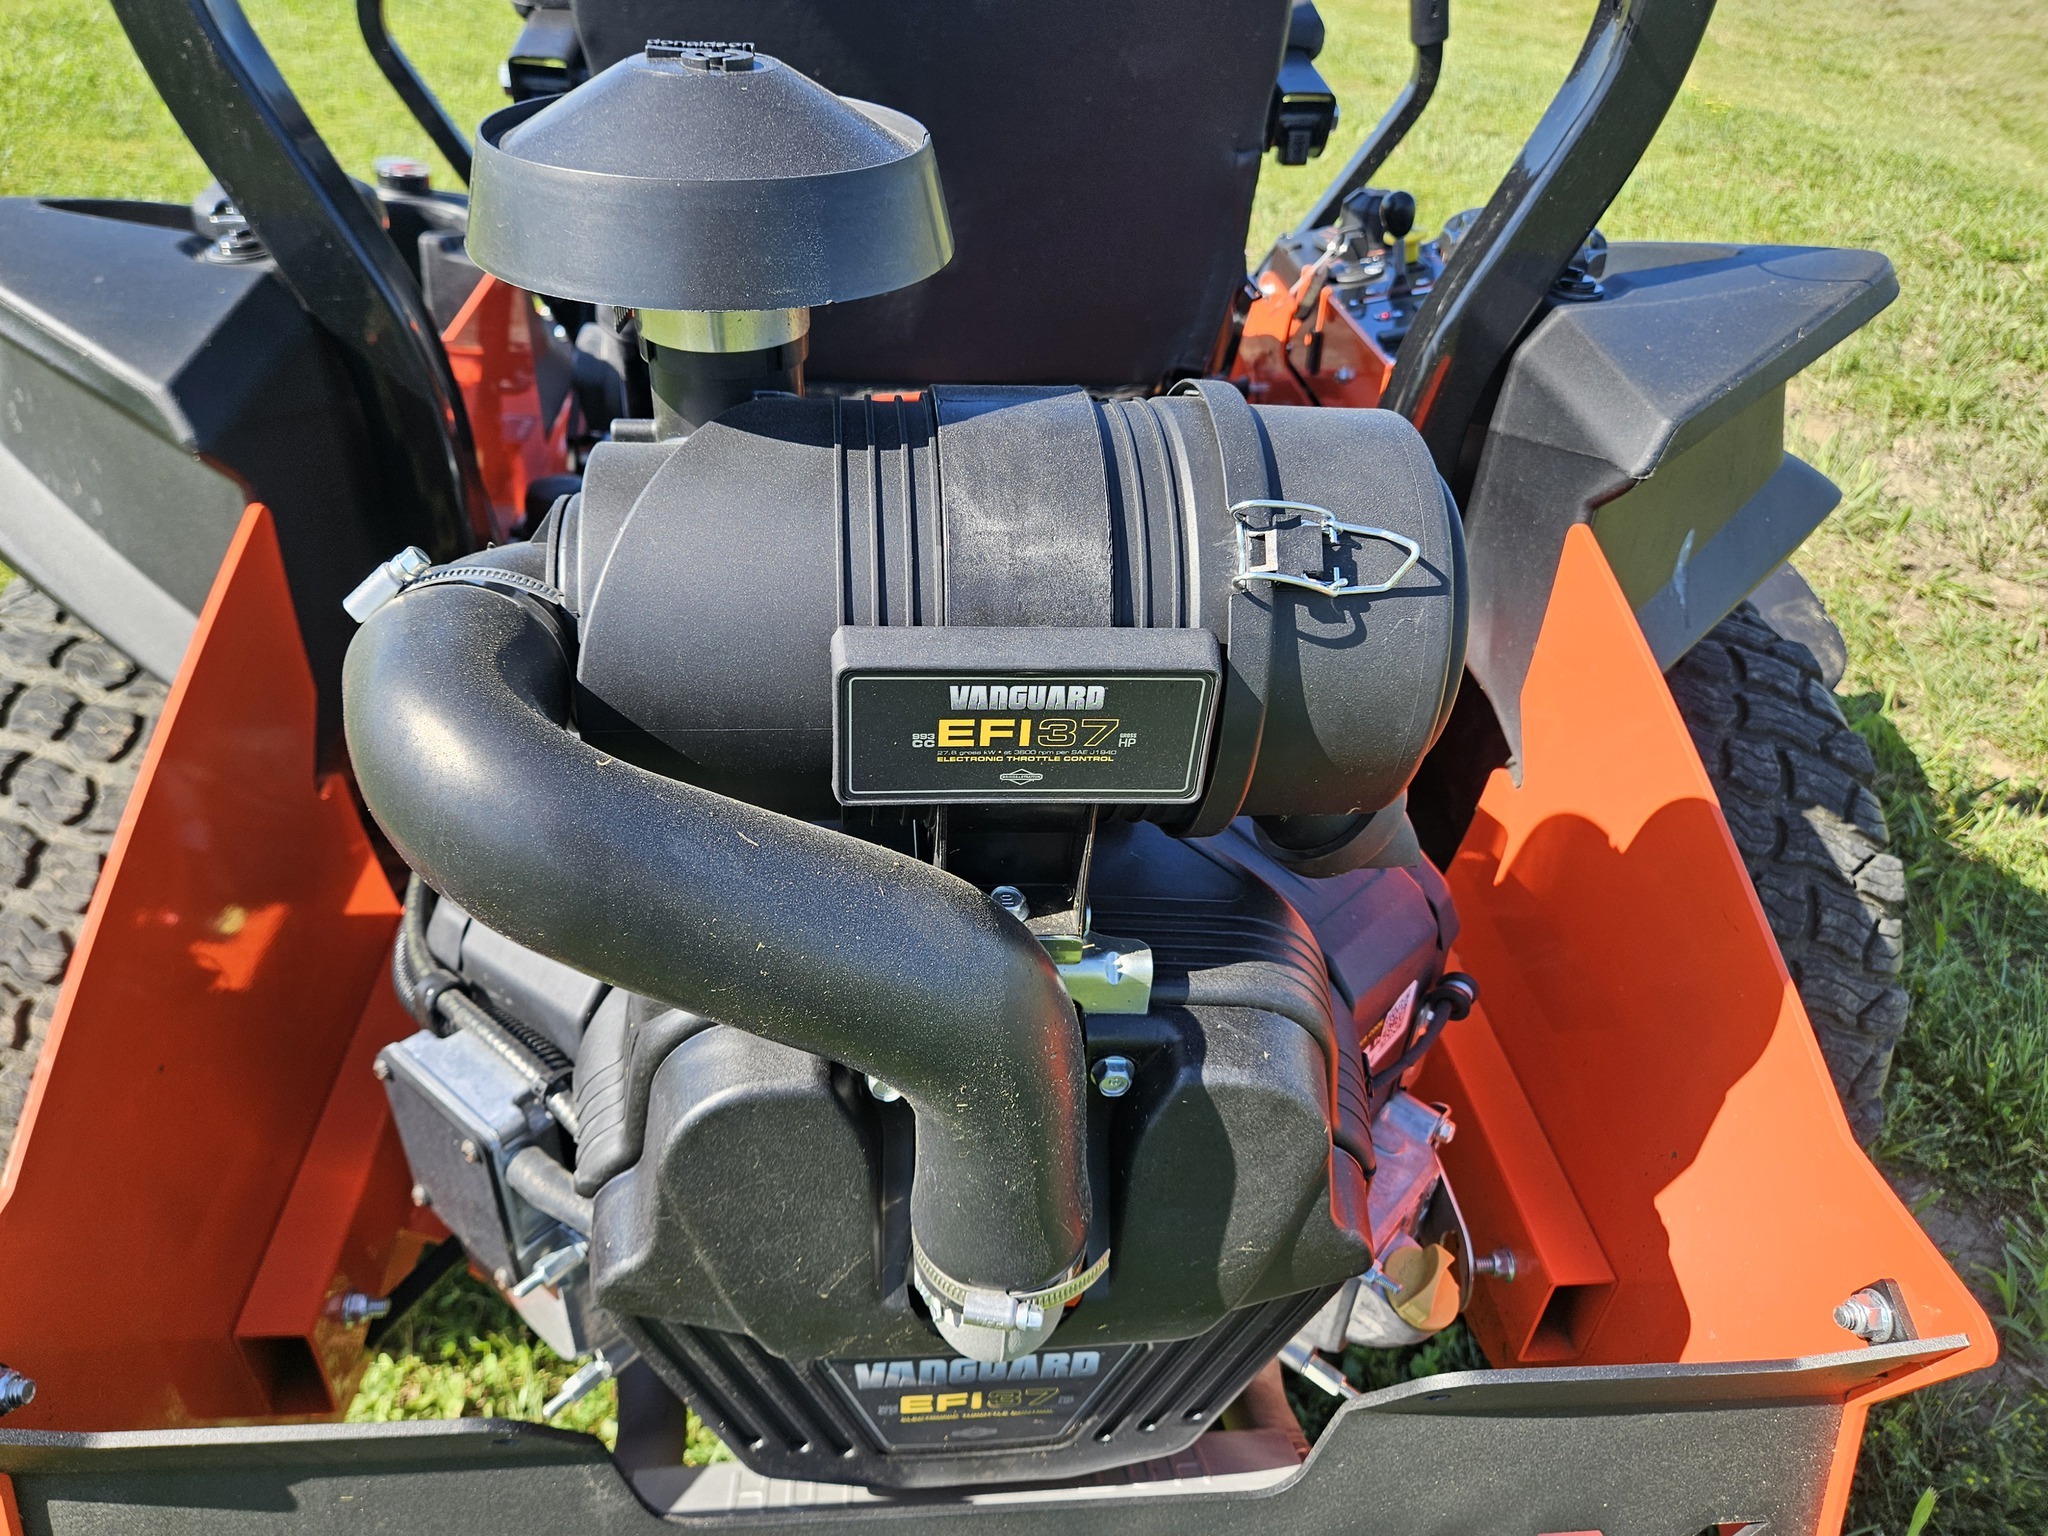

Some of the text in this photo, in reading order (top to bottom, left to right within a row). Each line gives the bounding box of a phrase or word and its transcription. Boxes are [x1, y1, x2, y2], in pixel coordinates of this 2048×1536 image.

[950, 685, 1105, 711] VANGUARD
[911, 739, 936, 748] CC
[1118, 738, 1137, 748] HP
[854, 1351, 1101, 1390] VANGUARD
